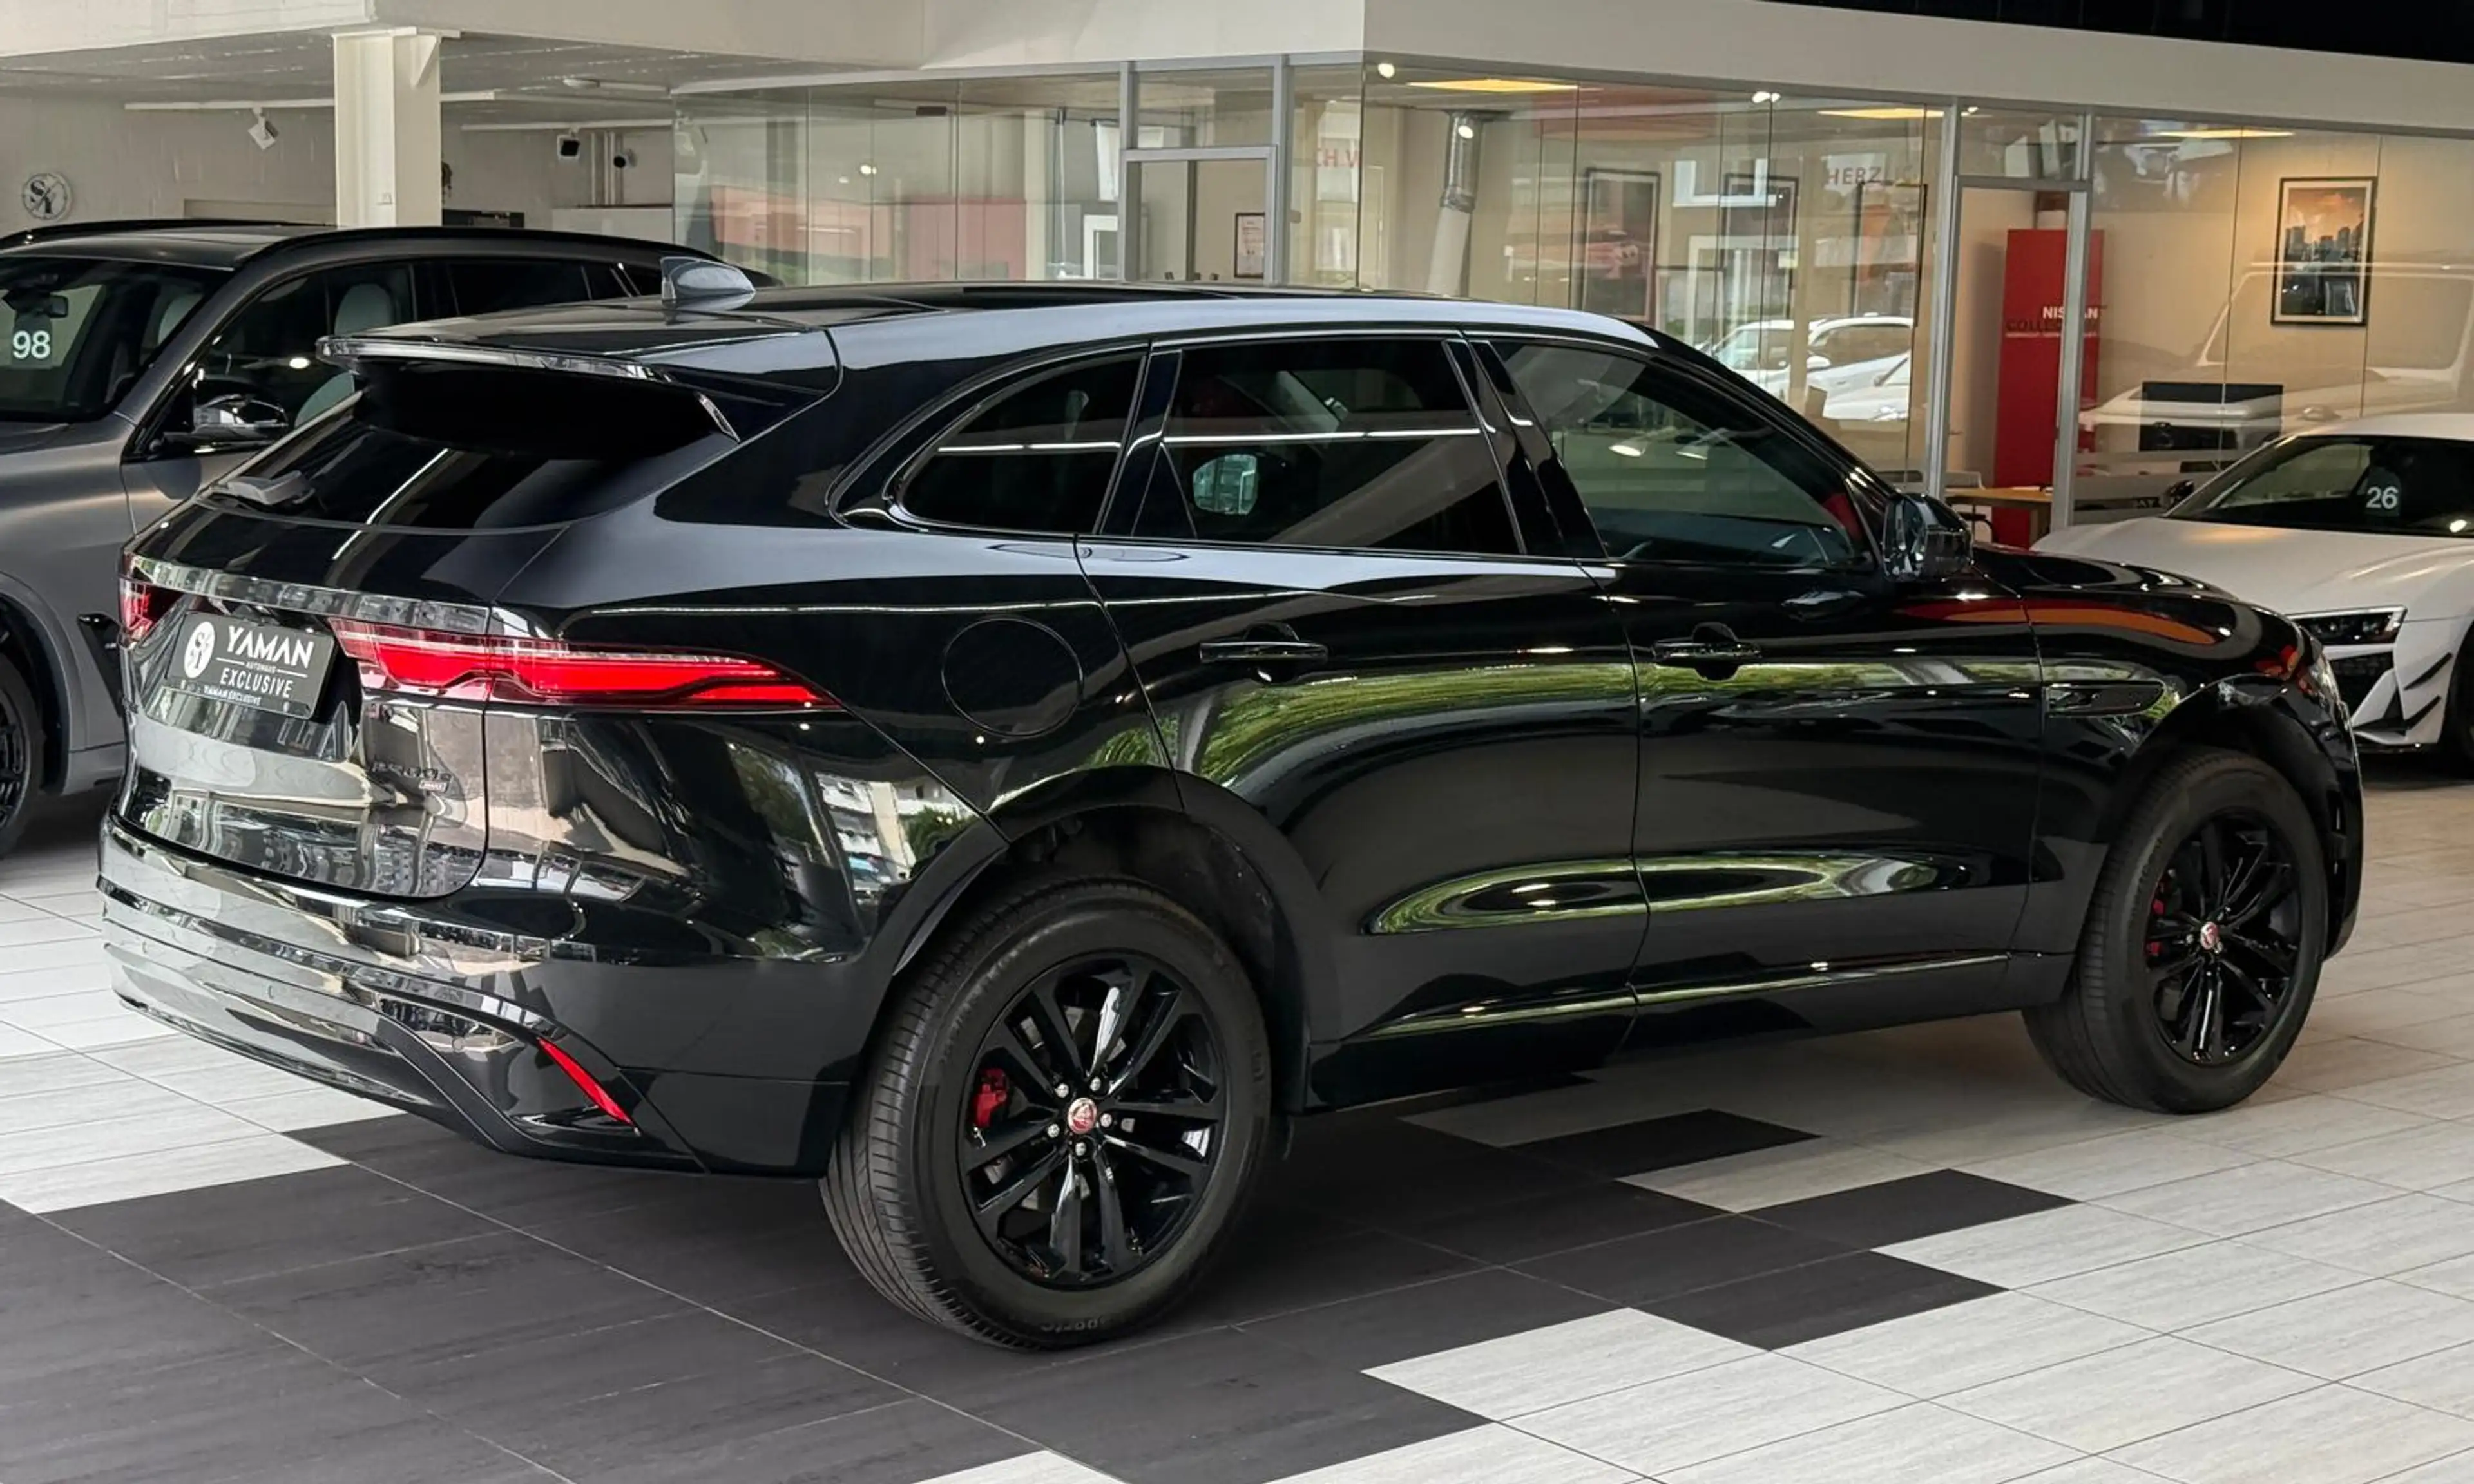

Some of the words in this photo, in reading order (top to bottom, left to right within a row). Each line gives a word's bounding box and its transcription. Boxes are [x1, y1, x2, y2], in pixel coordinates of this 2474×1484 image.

[2042, 306, 2098, 319] NISN
[13, 330, 50, 359] 98
[2366, 486, 2399, 509] 26
[227, 625, 314, 669] YAMAN
[220, 667, 294, 698] EXCLUSIVE
